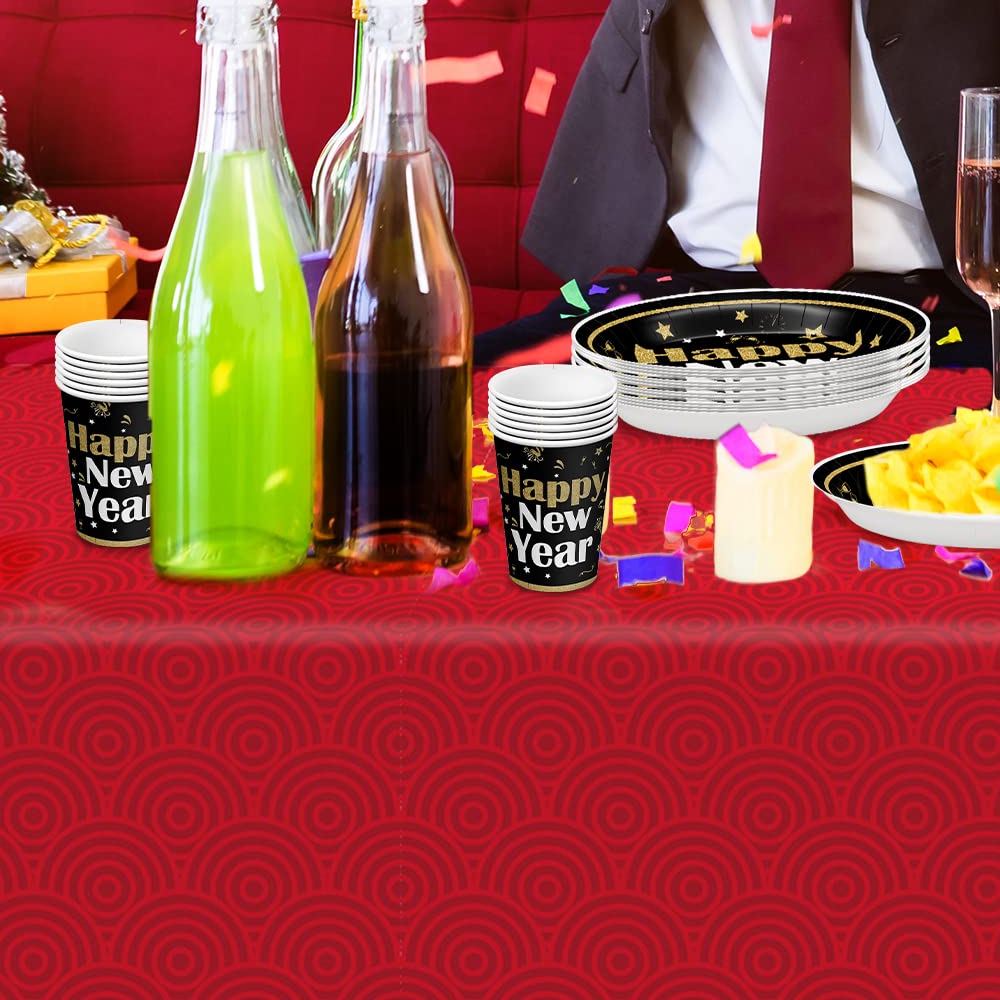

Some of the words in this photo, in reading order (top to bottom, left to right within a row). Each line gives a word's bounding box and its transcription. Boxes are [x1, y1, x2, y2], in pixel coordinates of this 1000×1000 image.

[633, 330, 863, 365] Happy
[67, 420, 153, 464] Happ
[85, 456, 153, 489] New
[500, 465, 606, 508] Happy
[518, 501, 592, 534] New
[510, 528, 594, 569] Year
